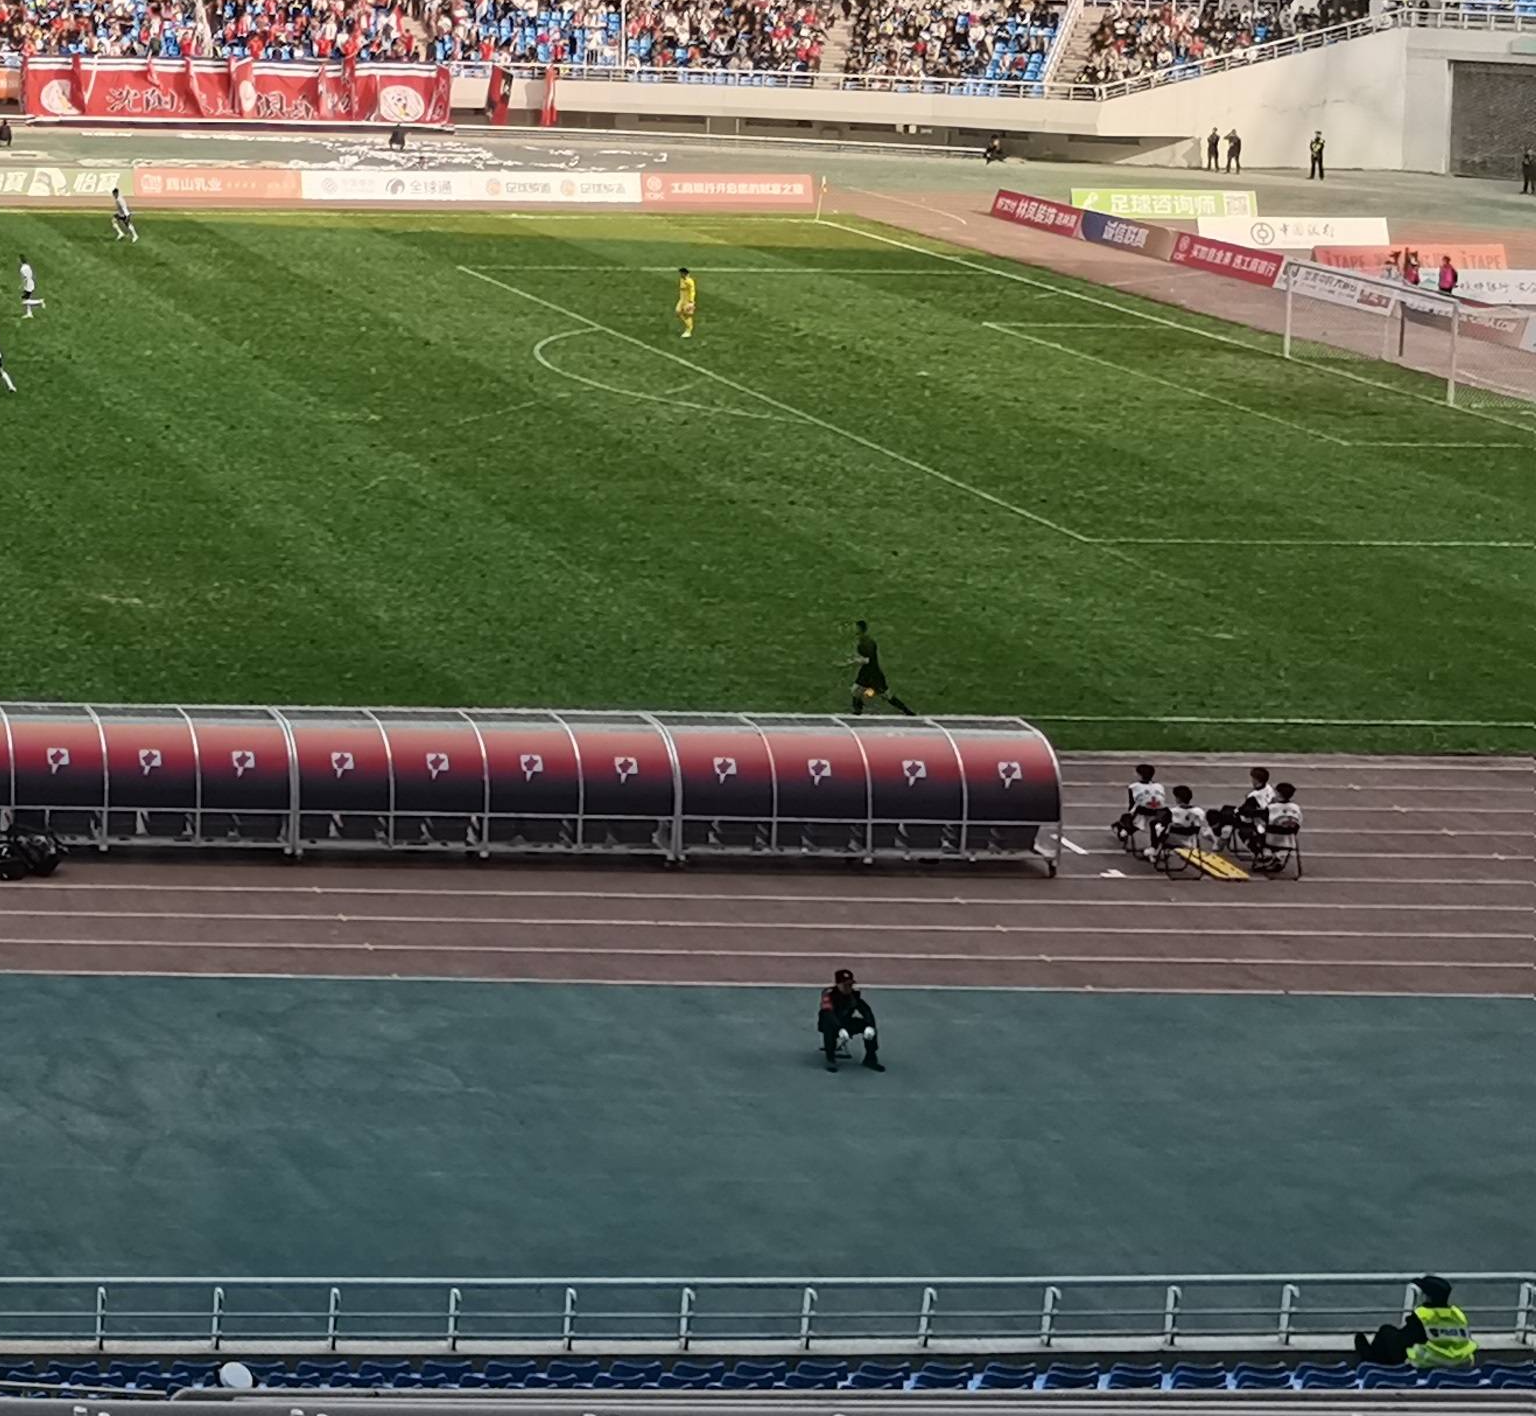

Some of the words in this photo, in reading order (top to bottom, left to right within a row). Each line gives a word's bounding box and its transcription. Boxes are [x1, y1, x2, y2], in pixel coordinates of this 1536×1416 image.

[1110, 193, 1216, 216] 足球咨询师
